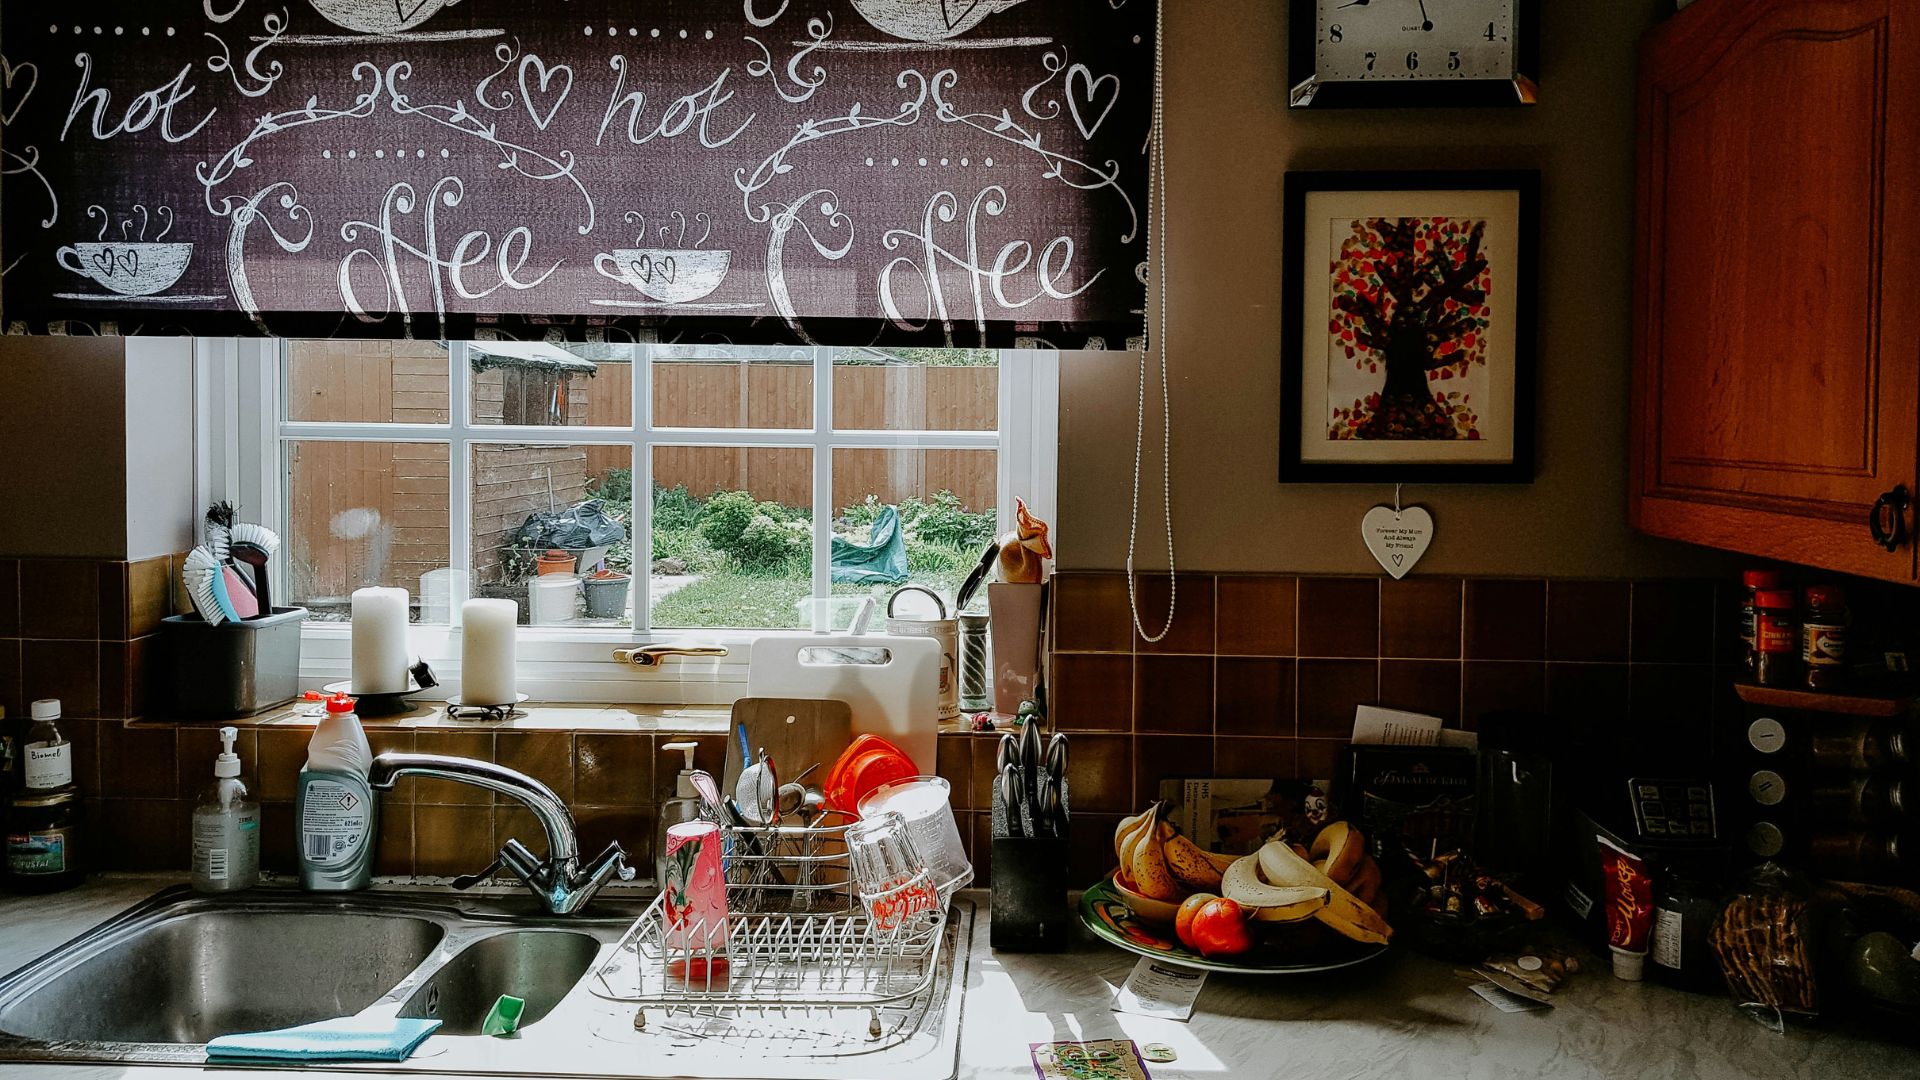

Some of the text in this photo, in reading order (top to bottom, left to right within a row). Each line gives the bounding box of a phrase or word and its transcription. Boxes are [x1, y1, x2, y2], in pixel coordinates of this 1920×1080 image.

[1329, 23, 1343, 43] 8
[1483, 22, 1496, 42] 4
[1364, 51, 1377, 71] 7
[1406, 51, 1419, 71] 6
[1447, 51, 1461, 71] 5
[60, 52, 217, 143] hot
[596, 54, 756, 148] hot
[224, 175, 566, 340] Coffee
[765, 185, 1107, 347] Coffee
